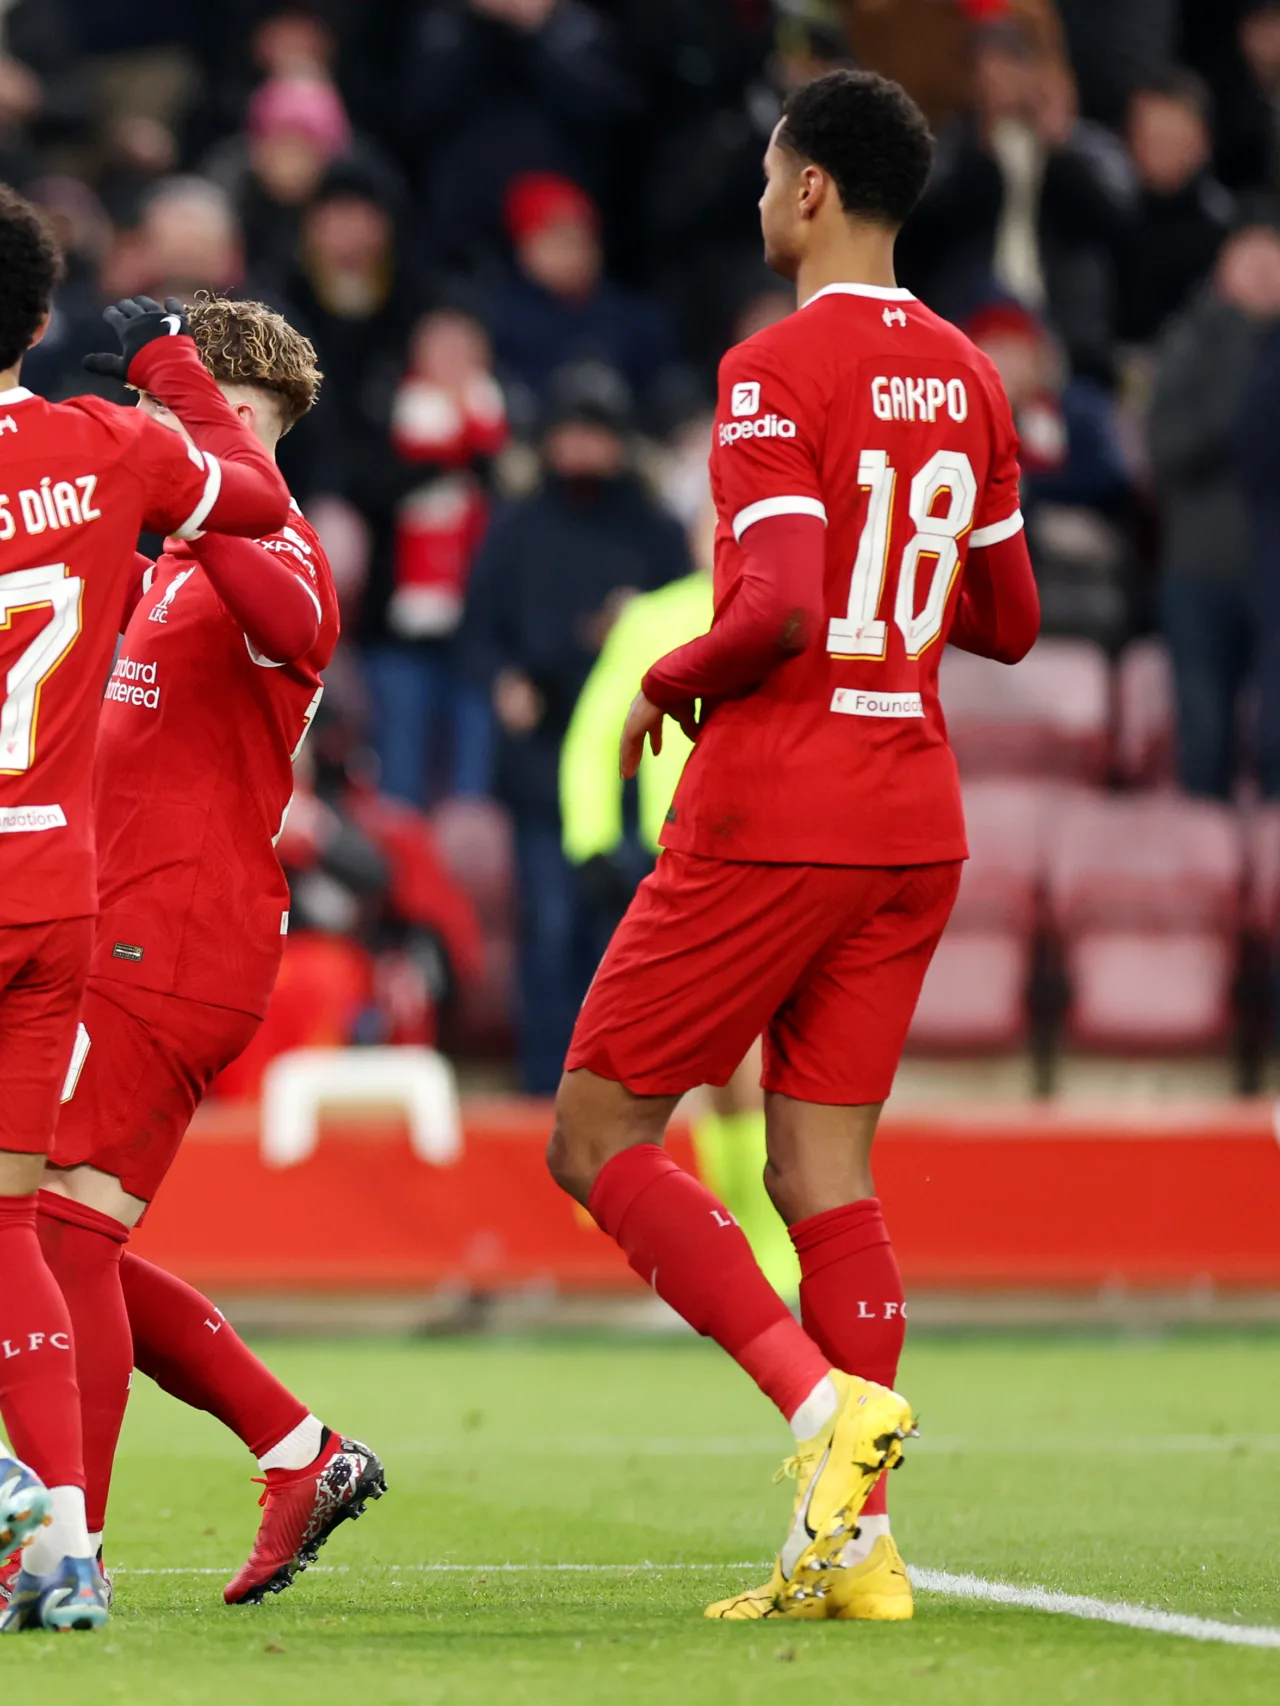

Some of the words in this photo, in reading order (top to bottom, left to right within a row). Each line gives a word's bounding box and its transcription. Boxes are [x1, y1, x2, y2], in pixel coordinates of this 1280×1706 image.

[871, 376, 968, 423] GAKPO
[18, 475, 101, 535] DÍAZ
[826, 449, 977, 661] 18
